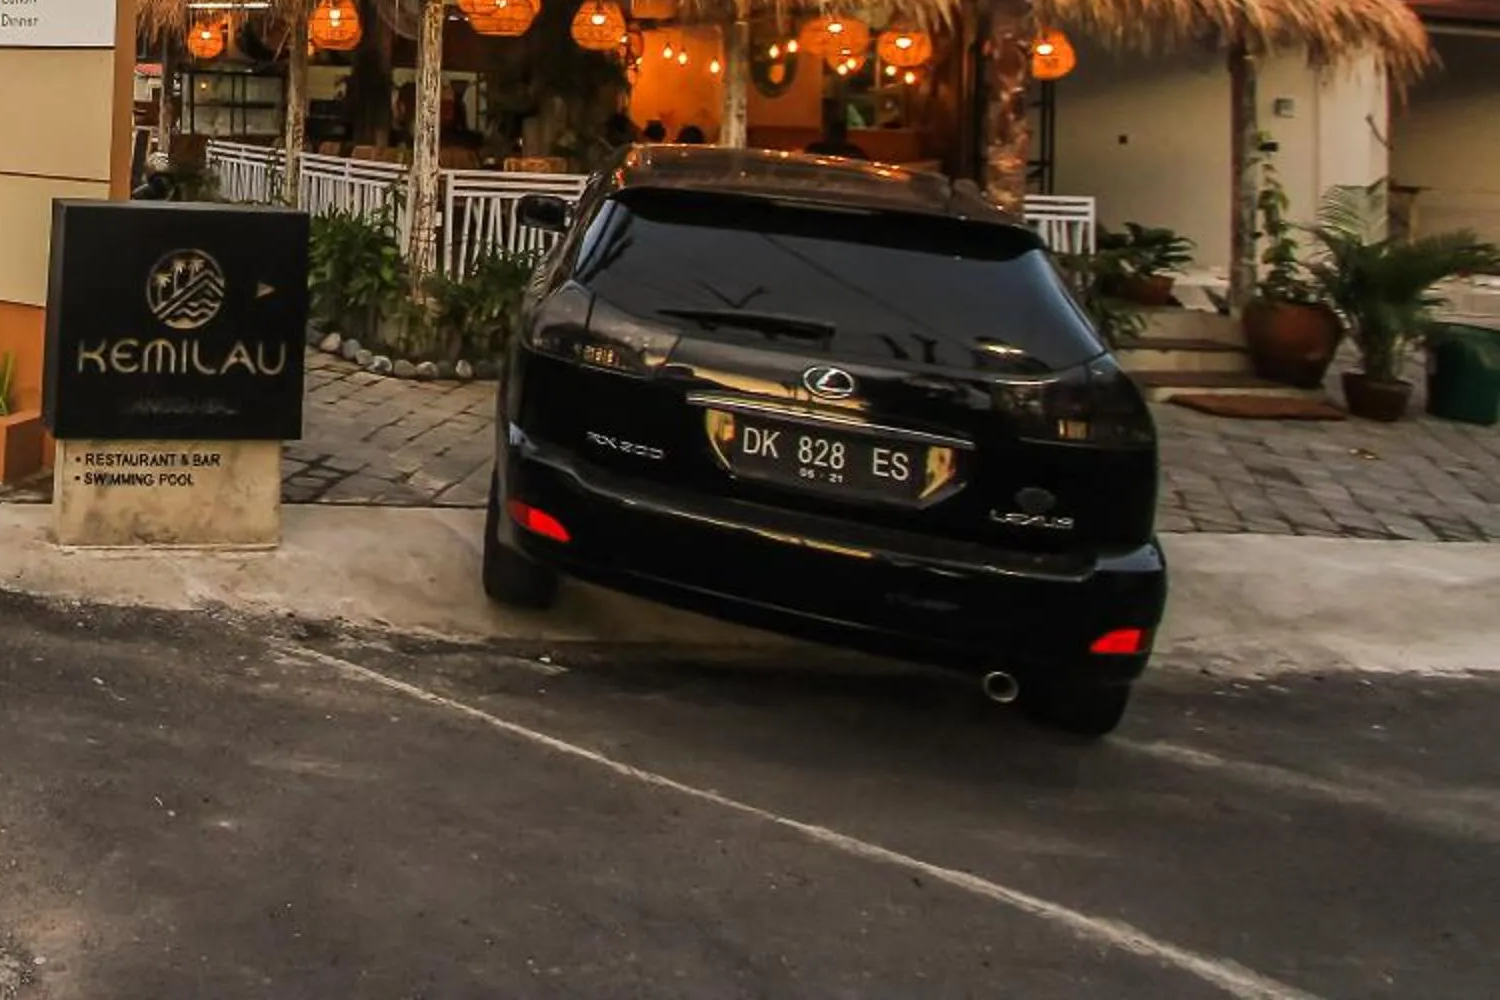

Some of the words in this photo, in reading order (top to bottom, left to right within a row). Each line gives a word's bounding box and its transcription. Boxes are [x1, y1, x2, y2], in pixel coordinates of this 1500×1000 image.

[1, 12, 39, 27] Dinner
[77, 338, 287, 375] KEMILAU
[85, 453, 176, 467] RESTAURANT
[193, 453, 221, 466] BAR
[743, 427, 780, 459] DK
[798, 435, 845, 470] 828
[872, 447, 909, 481] ES
[84, 472, 154, 486] SWIMMING
[159, 473, 195, 487] POOL
